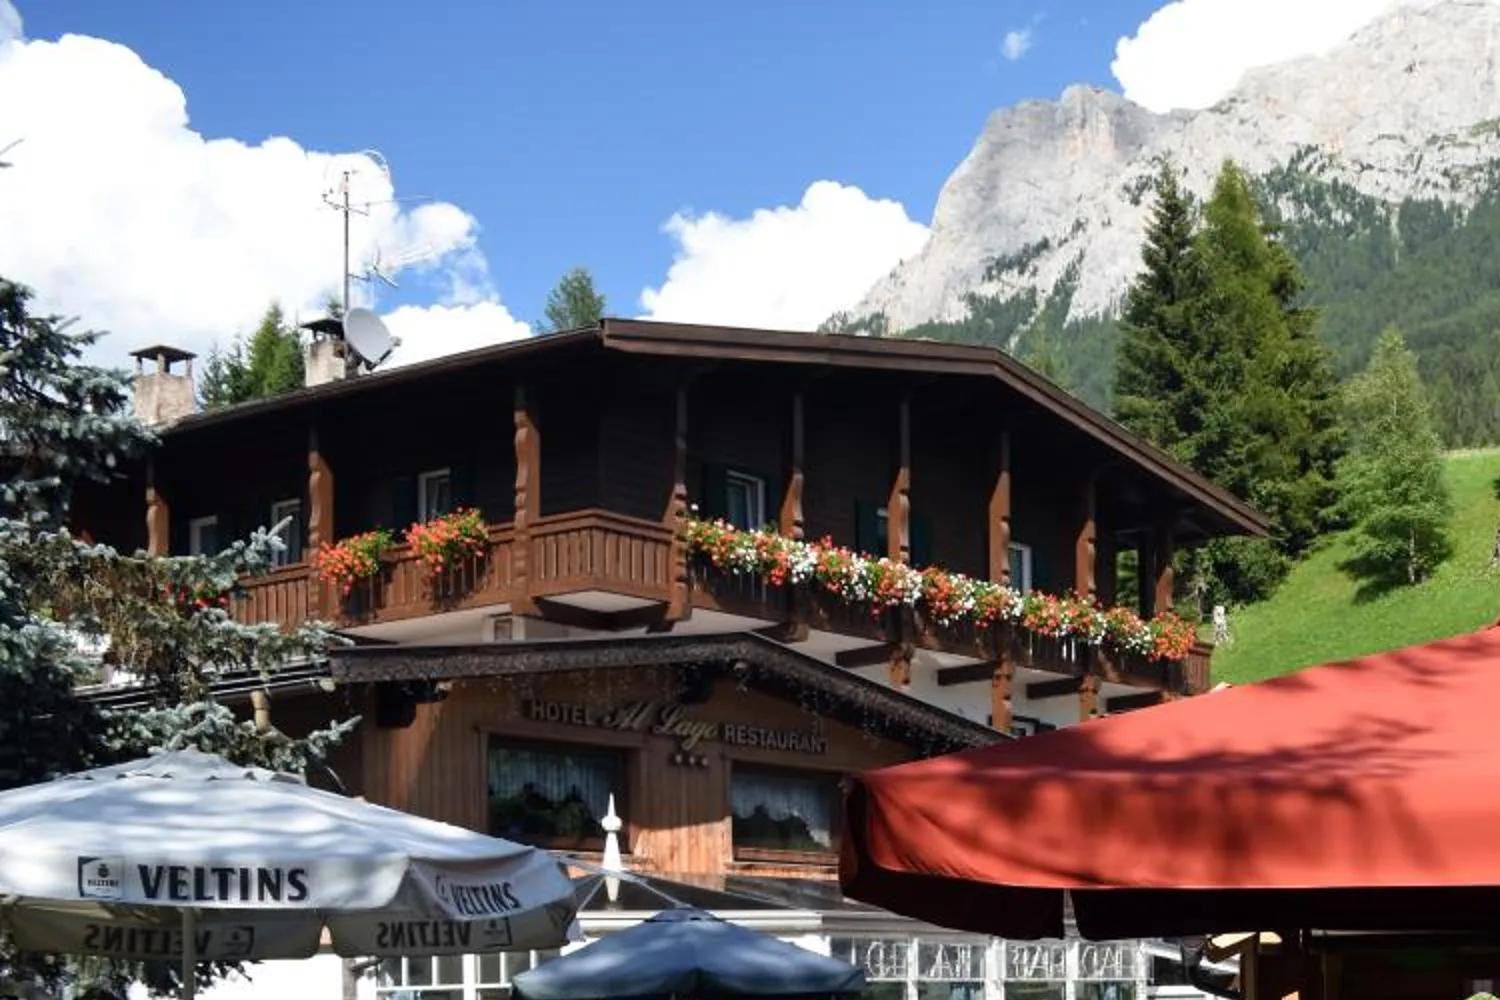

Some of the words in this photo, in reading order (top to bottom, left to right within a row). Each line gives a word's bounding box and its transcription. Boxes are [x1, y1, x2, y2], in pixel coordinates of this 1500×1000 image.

[531, 702, 594, 726] HOTEL
[137, 864, 309, 901] VELTINS
[450, 881, 520, 915] VELTINS
